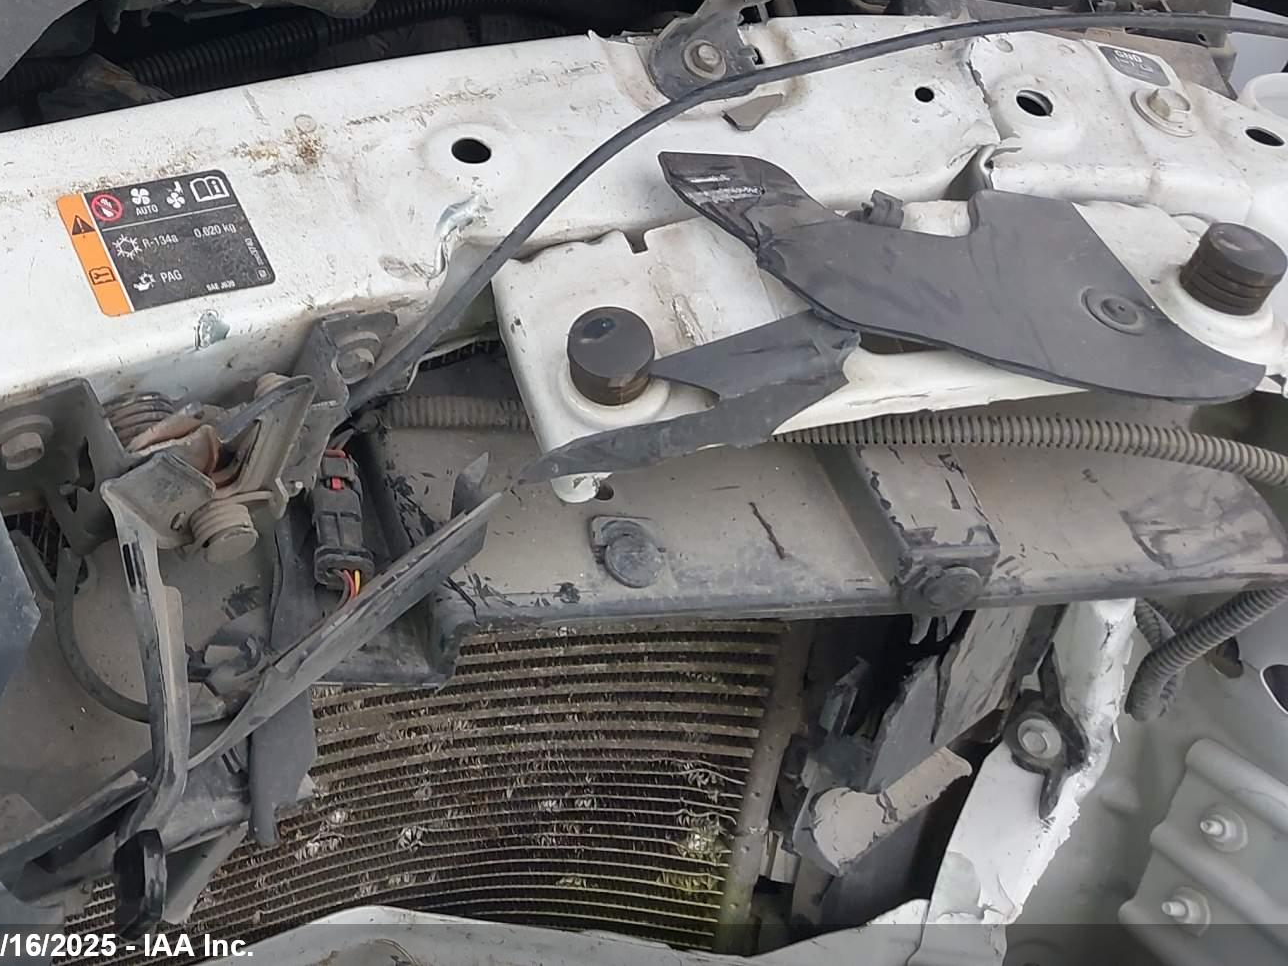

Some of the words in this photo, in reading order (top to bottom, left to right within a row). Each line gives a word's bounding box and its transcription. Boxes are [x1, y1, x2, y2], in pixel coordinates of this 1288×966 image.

[135, 205, 159, 217] AUTO
[141, 234, 179, 250] R-134a
[159, 269, 183, 284] PAG
